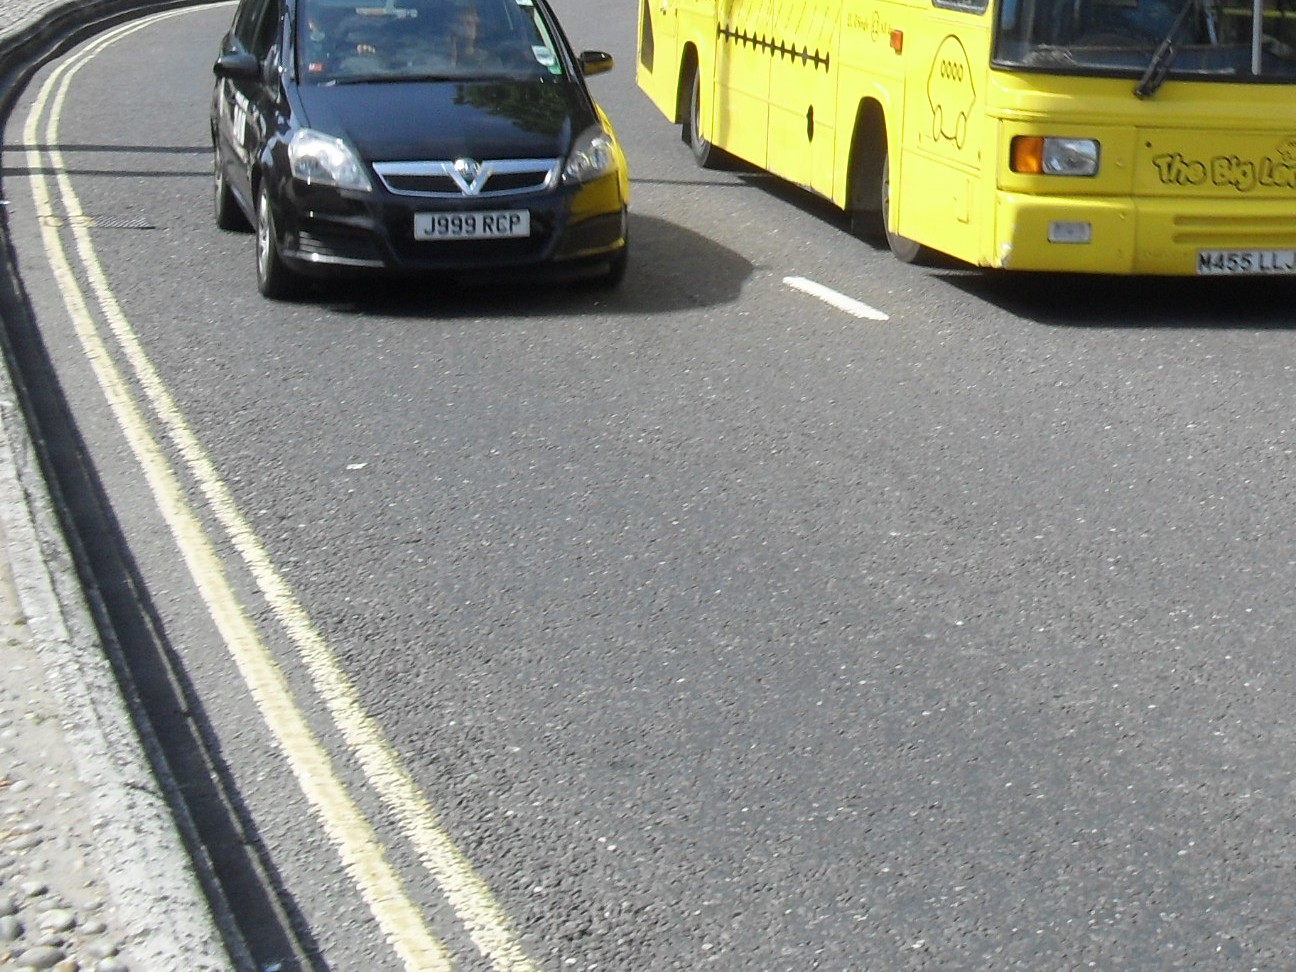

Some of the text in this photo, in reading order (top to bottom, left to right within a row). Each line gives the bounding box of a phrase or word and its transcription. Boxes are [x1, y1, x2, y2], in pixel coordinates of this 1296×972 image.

[1152, 152, 1207, 186] The
[1210, 154, 1257, 192] Big
[424, 213, 521, 236] J999 RCP
